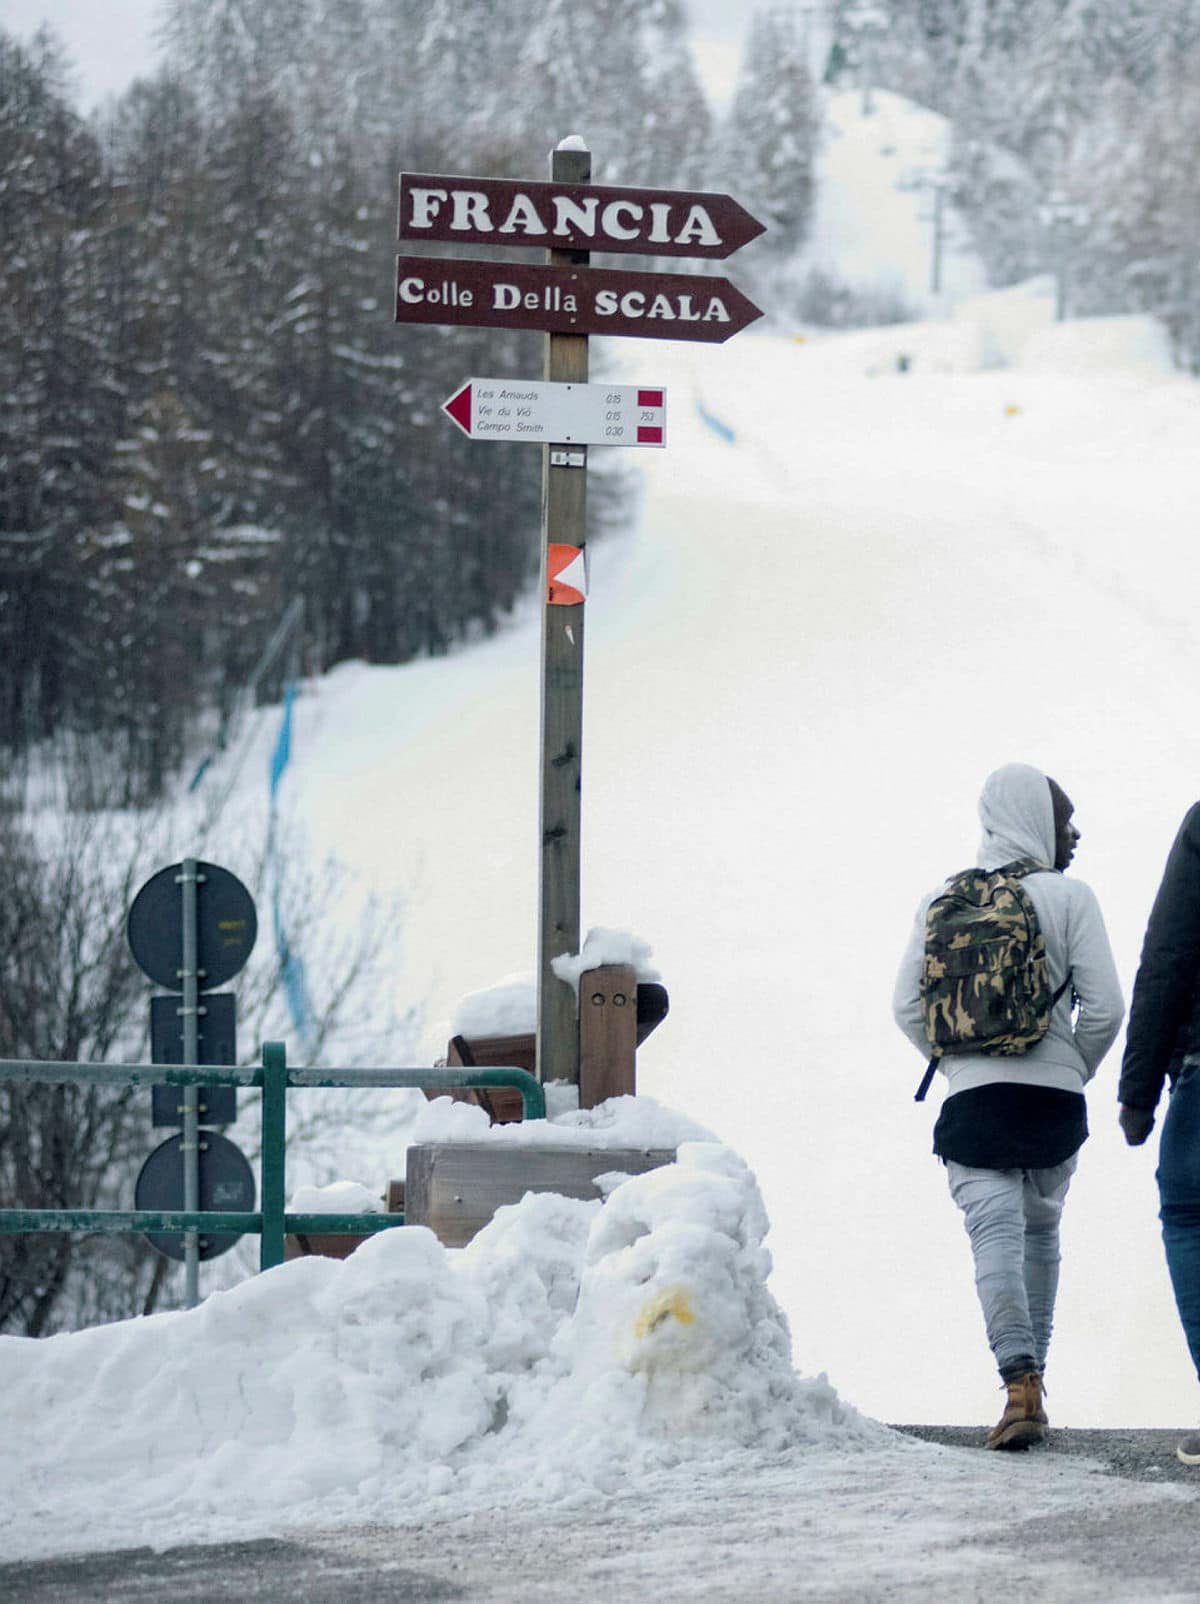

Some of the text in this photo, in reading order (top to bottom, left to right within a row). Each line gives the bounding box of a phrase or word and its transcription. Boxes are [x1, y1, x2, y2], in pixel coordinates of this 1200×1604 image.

[408, 188, 723, 246] FRANCIA
[399, 277, 731, 322] Colle Della SCALA
[477, 390, 494, 399] Les
[477, 421, 544, 433] Campo Smith
